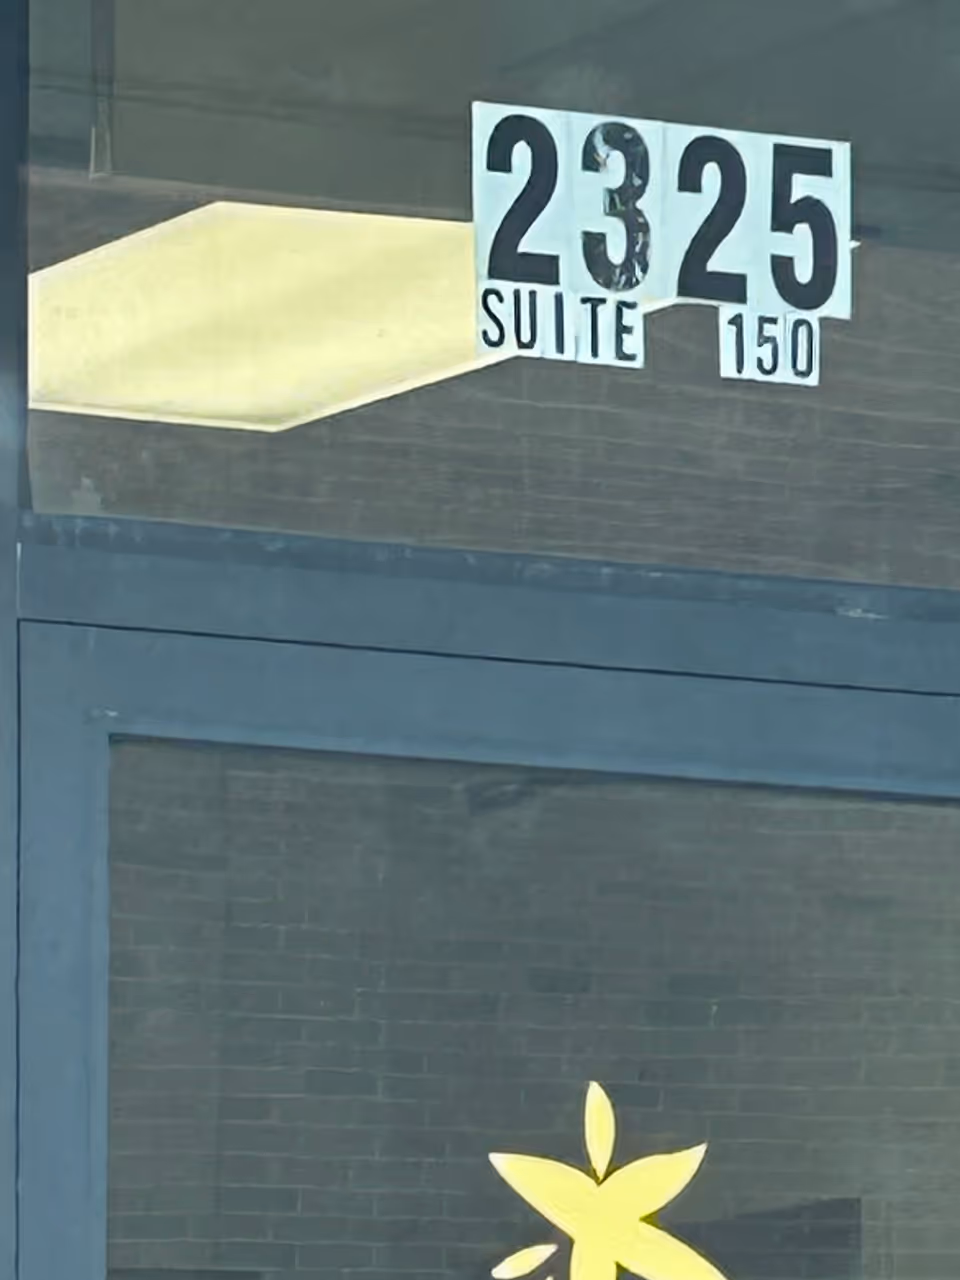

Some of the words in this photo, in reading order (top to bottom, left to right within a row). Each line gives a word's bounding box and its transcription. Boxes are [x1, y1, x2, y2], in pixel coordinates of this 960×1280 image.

[486, 113, 838, 311] 2325
[481, 288, 638, 361] SUITE
[726, 312, 814, 379] 150
